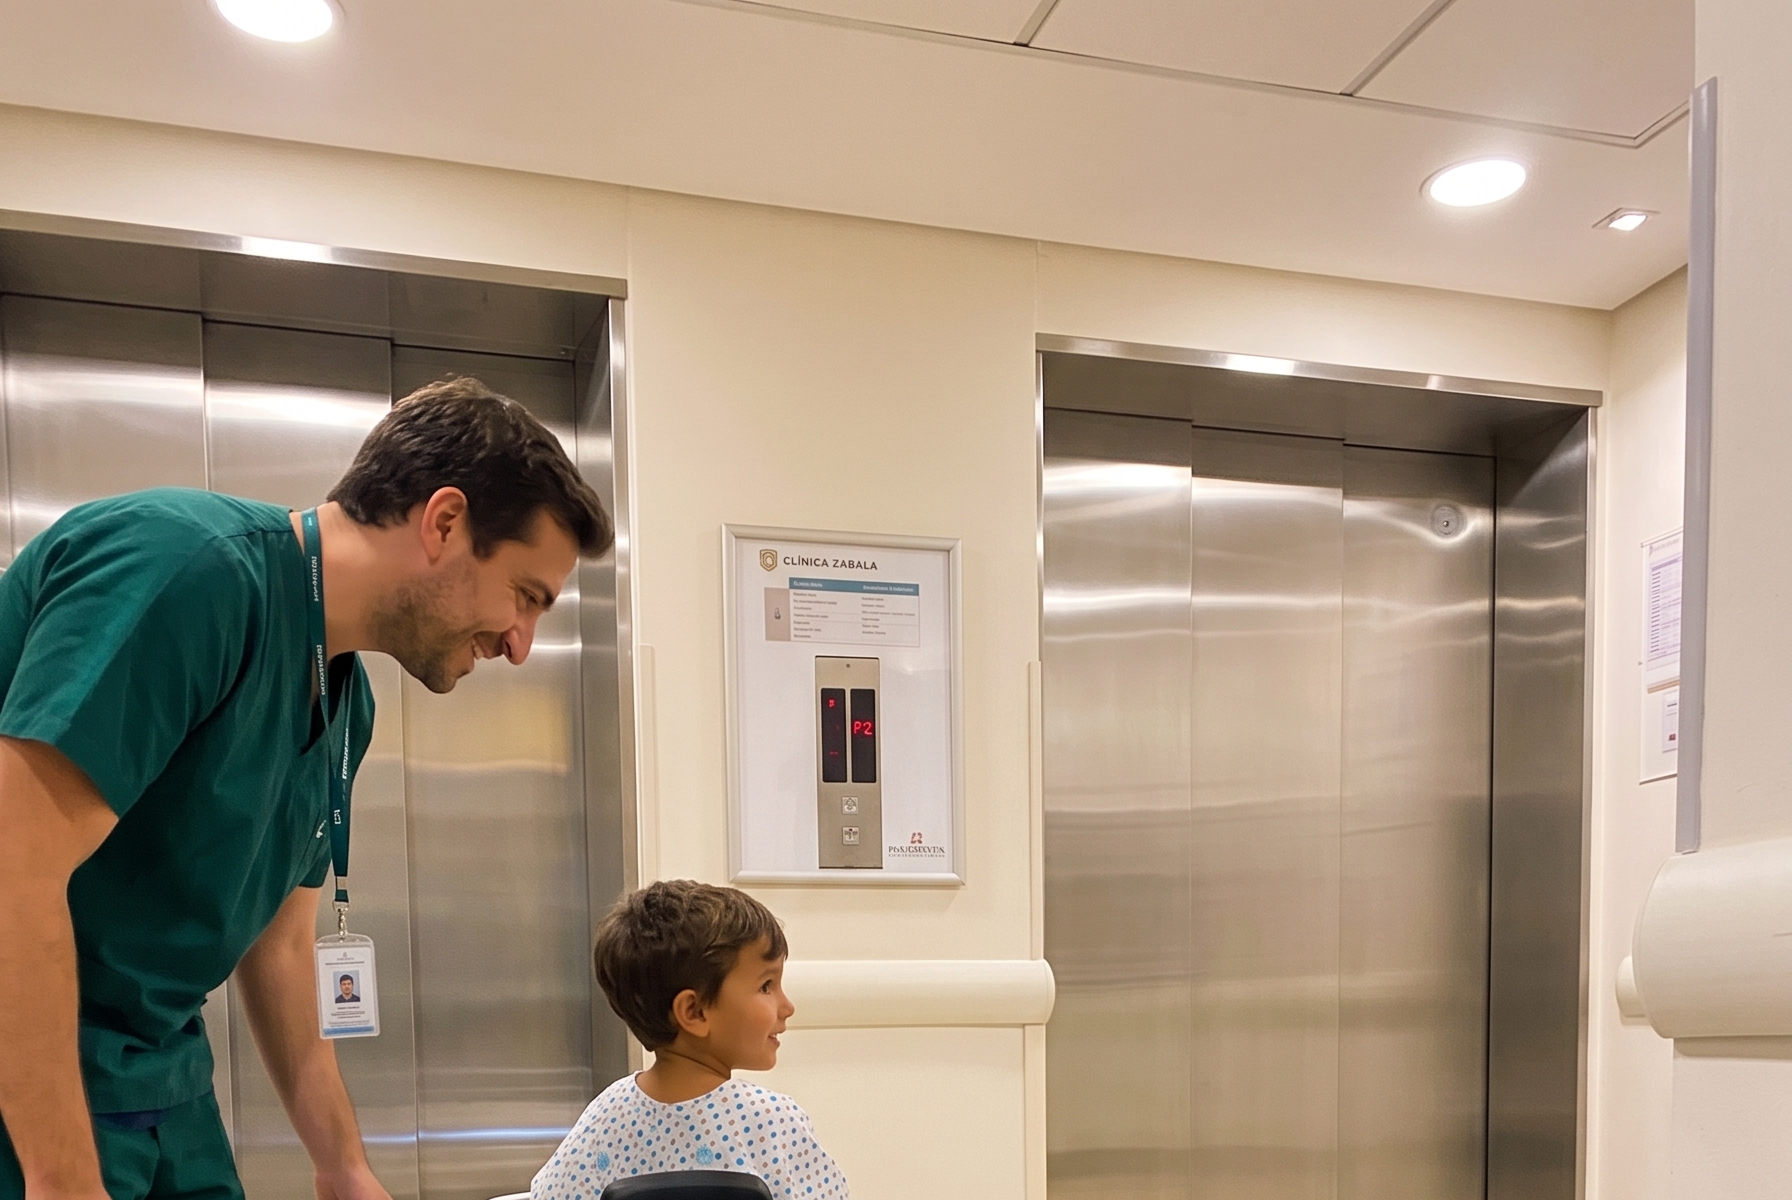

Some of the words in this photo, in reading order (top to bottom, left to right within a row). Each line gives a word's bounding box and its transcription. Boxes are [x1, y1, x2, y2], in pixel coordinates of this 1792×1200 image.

[783, 555, 829, 568] CLÍNICA
[832, 559, 878, 570] ZABALA
[853, 720, 873, 735] P2
